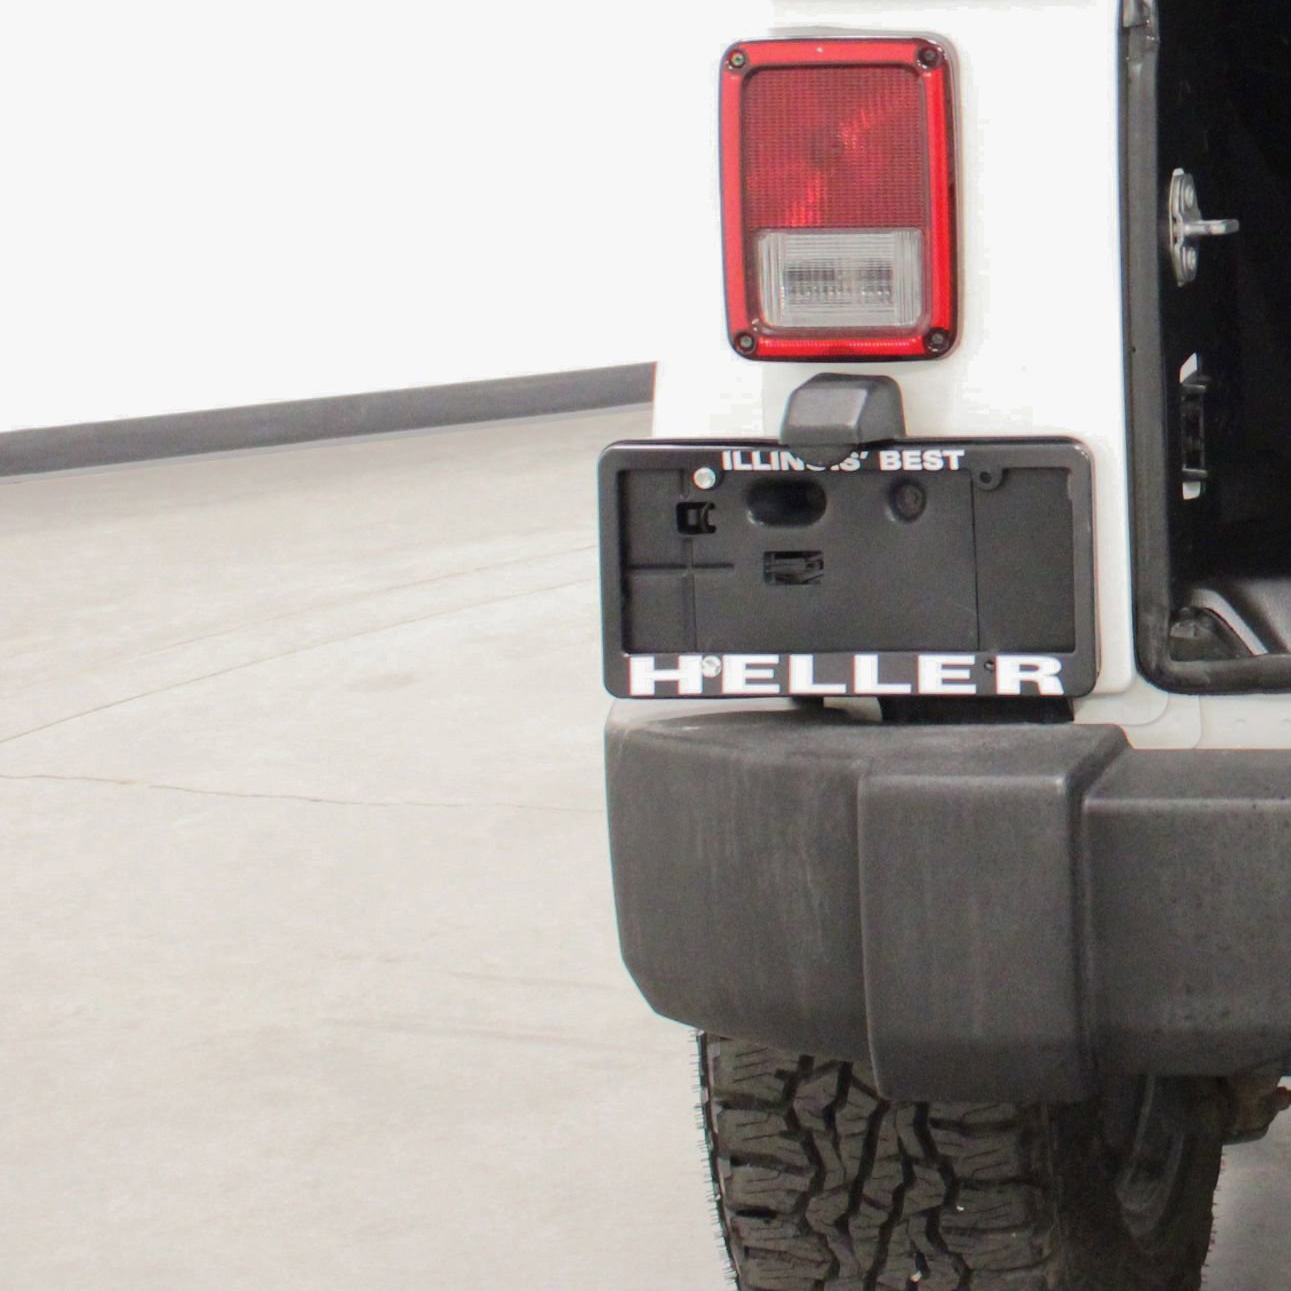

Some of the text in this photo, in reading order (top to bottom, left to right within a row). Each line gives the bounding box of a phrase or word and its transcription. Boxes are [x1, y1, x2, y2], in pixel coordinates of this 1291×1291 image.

[721, 449, 966, 472] ILLINS' BEST
[628, 653, 1065, 696] HELLER
